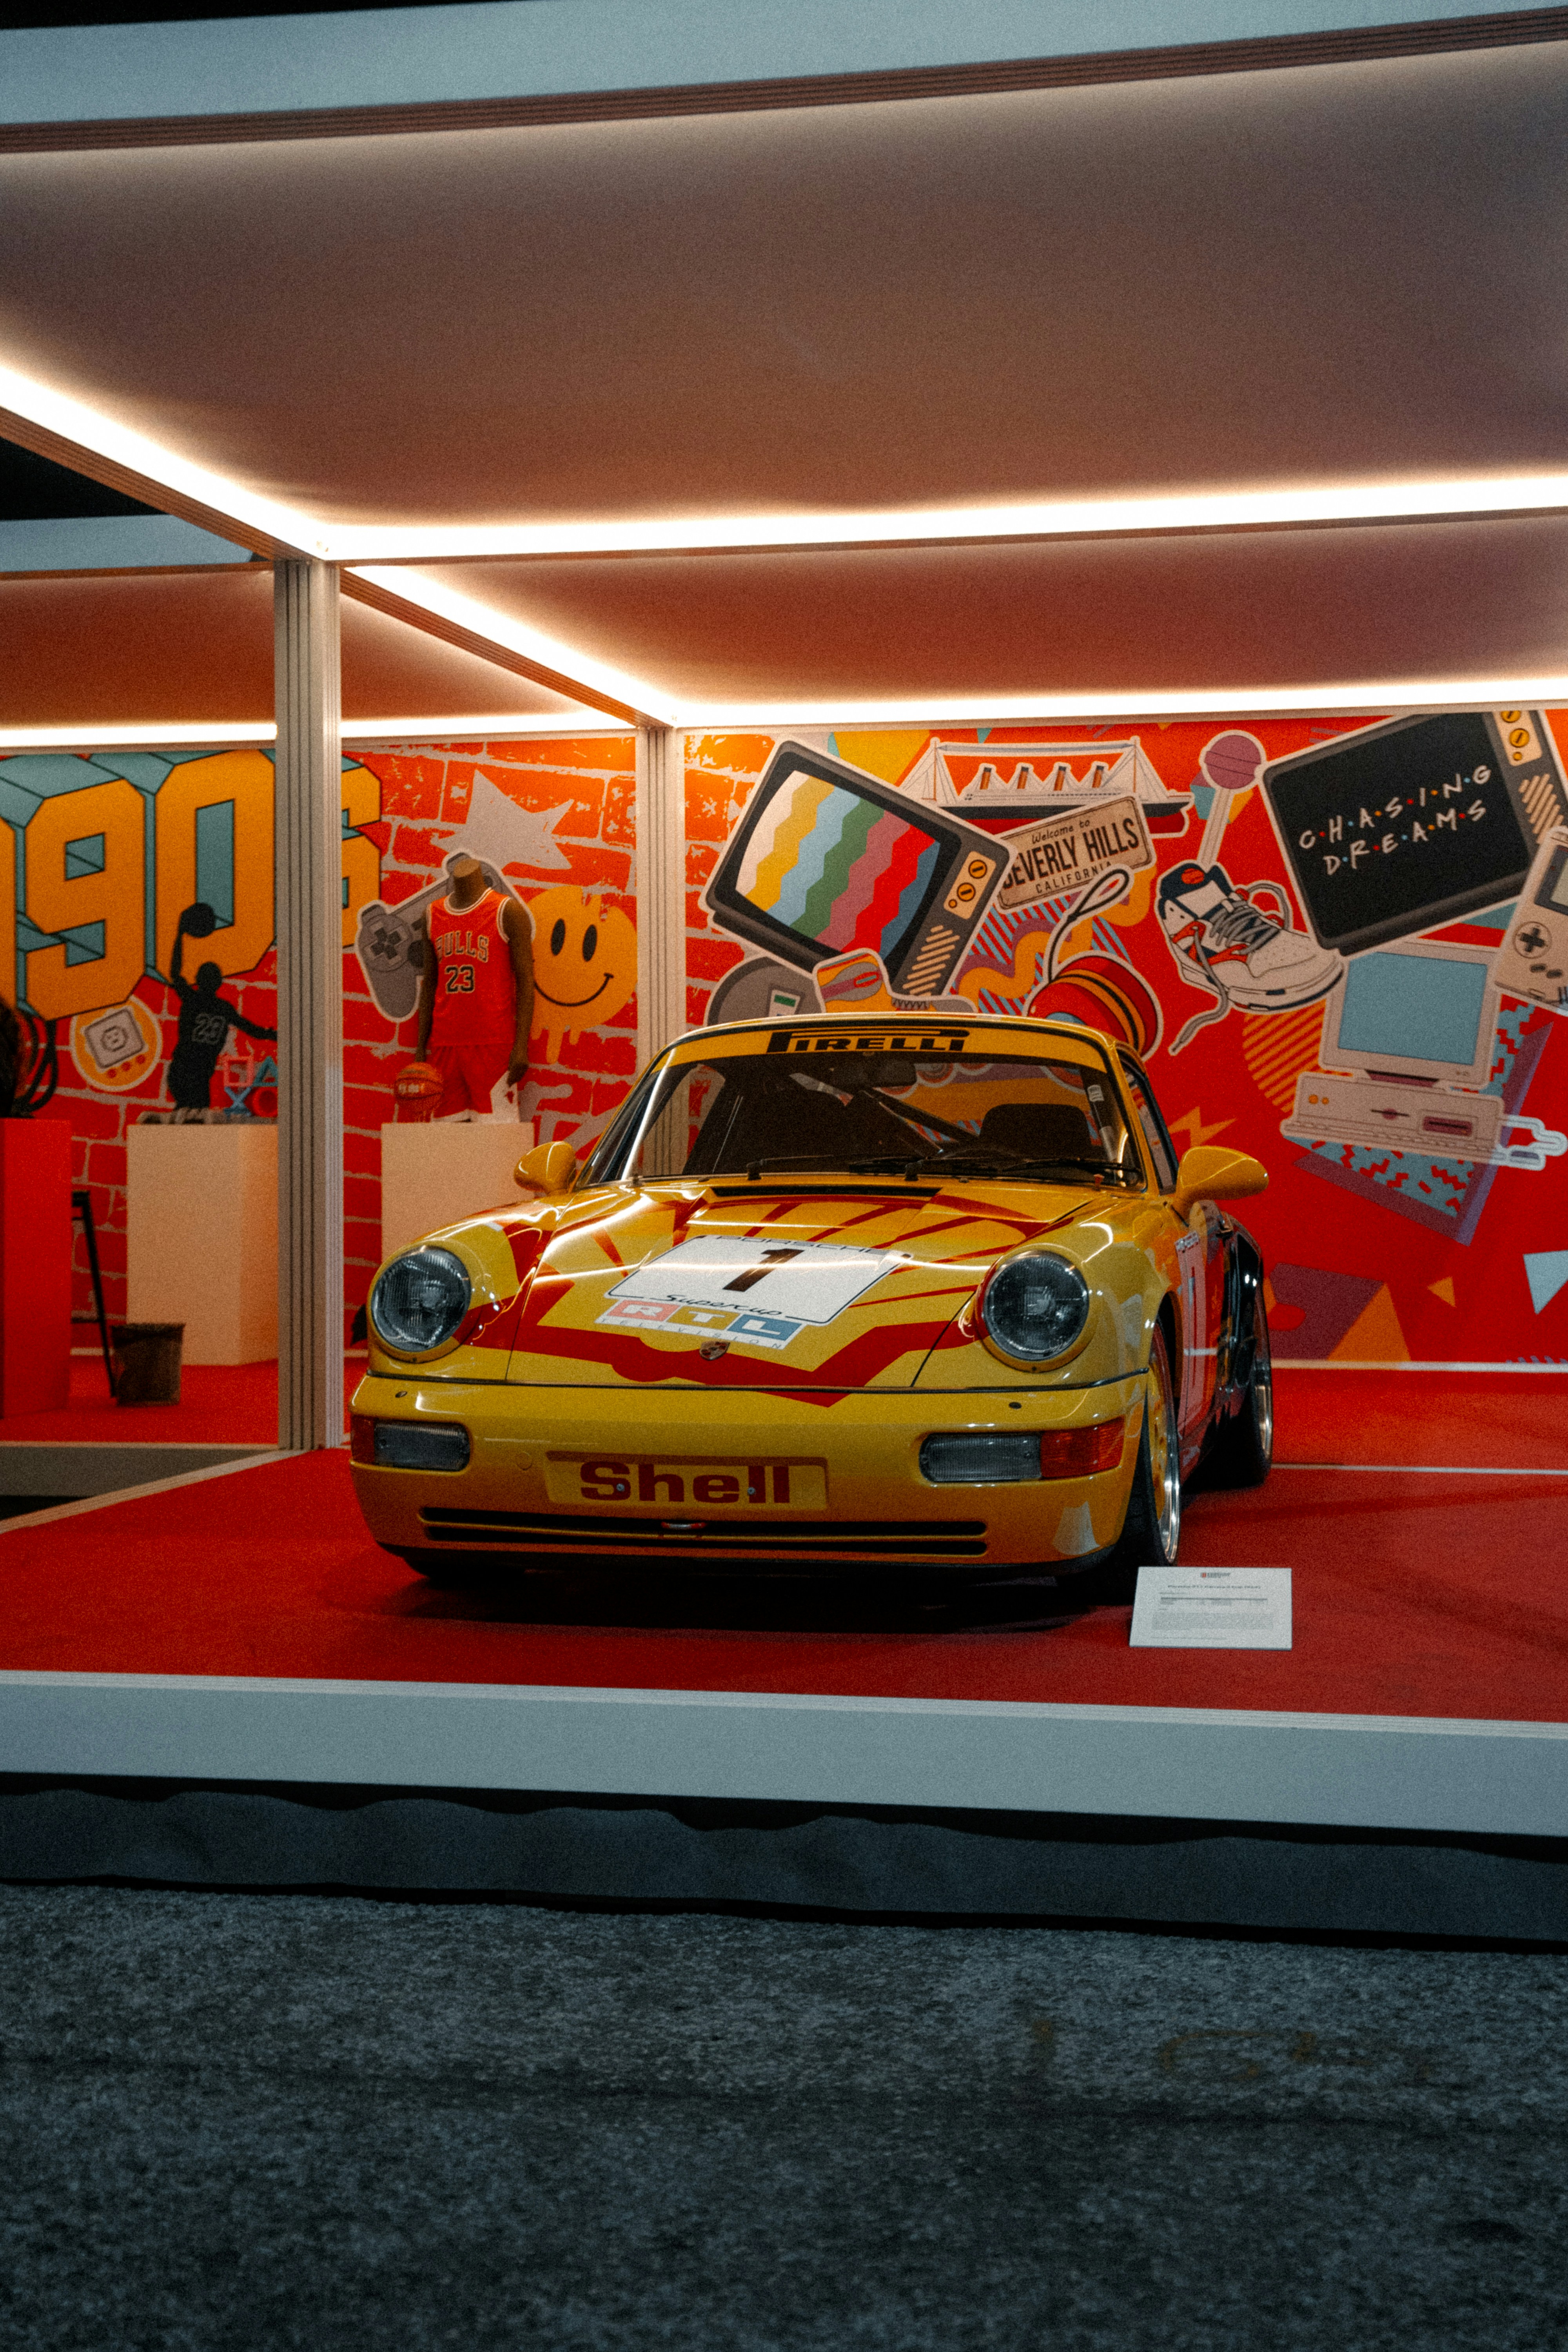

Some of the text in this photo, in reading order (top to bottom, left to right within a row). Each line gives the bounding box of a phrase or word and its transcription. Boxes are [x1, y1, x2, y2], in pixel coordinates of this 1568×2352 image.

[1032, 819, 1091, 844] Welcome to
[1082, 817, 1139, 862] HILLS
[445, 964, 475, 994] 23
[191, 1013, 226, 1044] 23
[766, 1027, 970, 1053] PIRELLI
[716, 1236, 891, 1256] PORSCHE
[722, 1248, 805, 1292] 1
[621, 1303, 782, 1335] RTL
[651, 1294, 782, 1316] Supercup
[601, 1318, 783, 1349] TELEVISION
[580, 1461, 791, 1504] Shell
